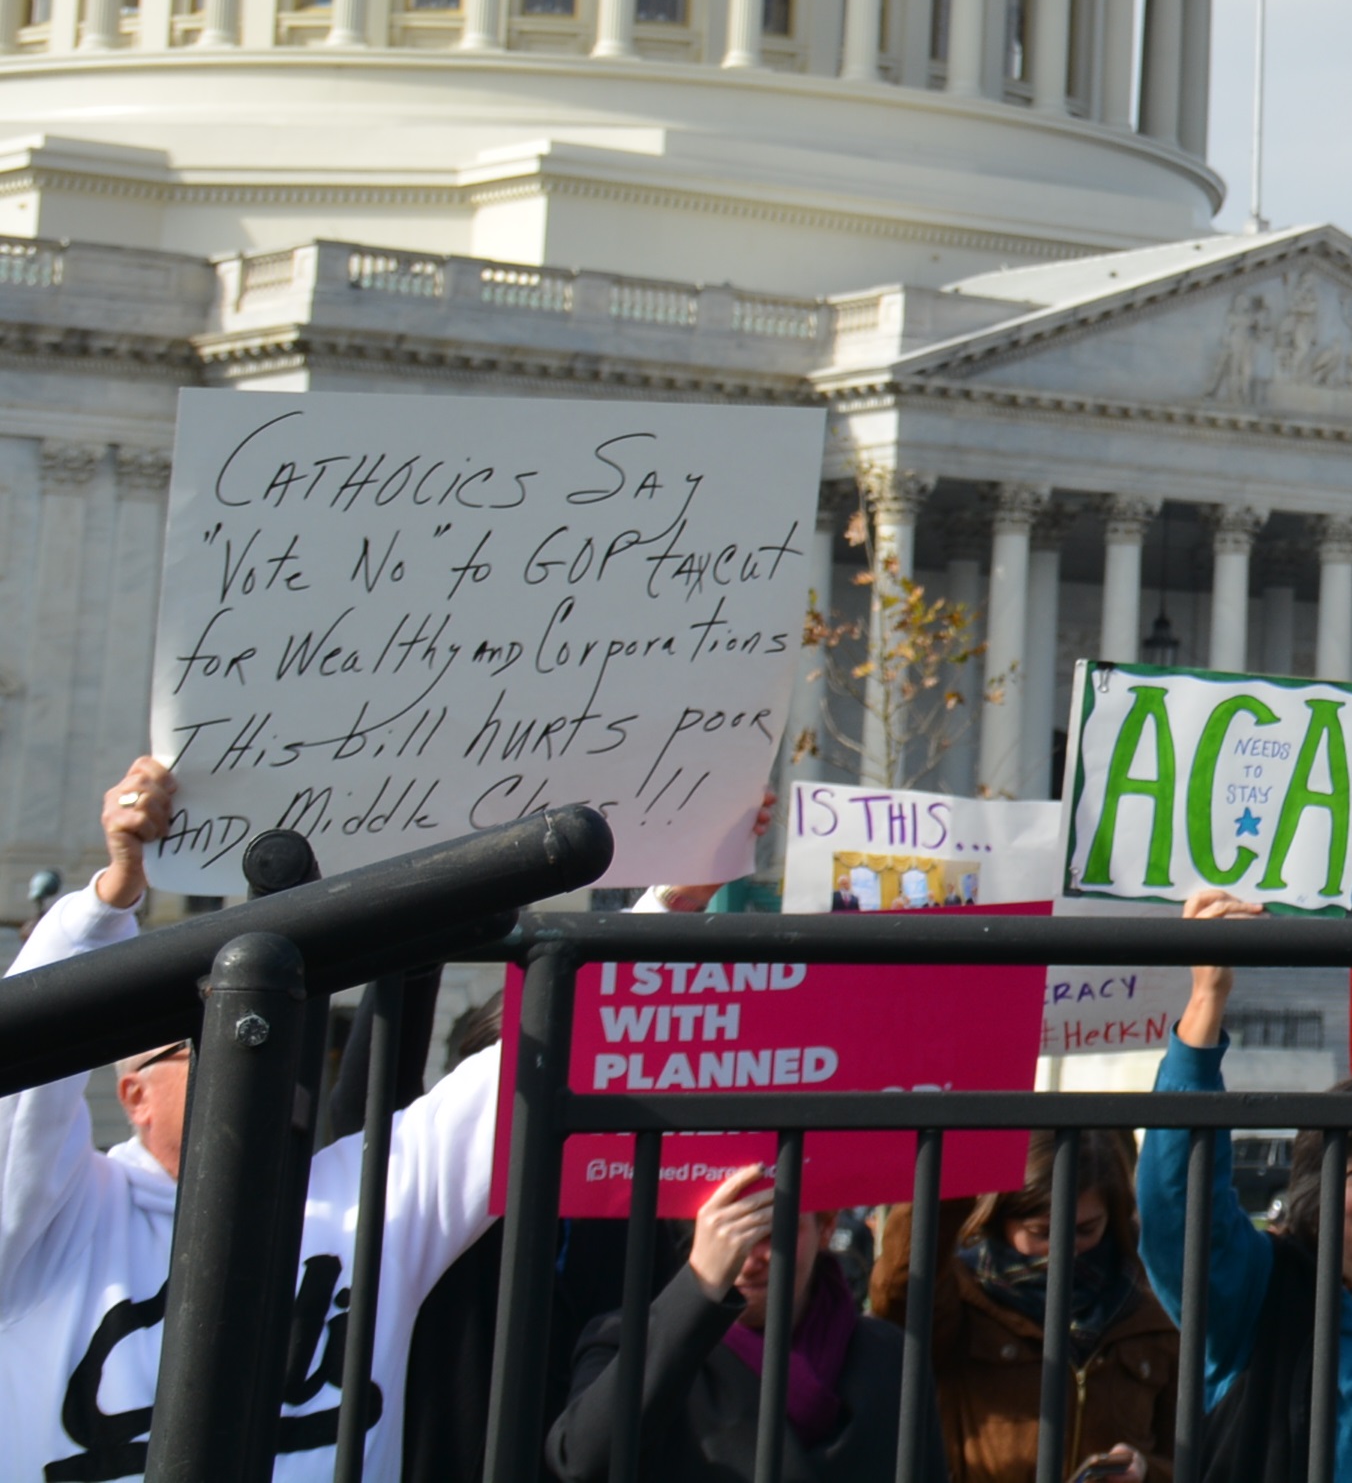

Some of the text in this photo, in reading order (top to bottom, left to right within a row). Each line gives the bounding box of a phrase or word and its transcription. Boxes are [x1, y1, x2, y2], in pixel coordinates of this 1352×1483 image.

[447, 529, 492, 601] to
[524, 525, 641, 582] GOP
[274, 606, 462, 701] Wealthy
[1234, 737, 1291, 760] NEEDS
[1080, 685, 1351, 897] ACA
[1244, 765, 1263, 778] TO
[1227, 784, 1273, 804] STAY
[797, 787, 992, 850] IS THIS...
[600, 962, 807, 996] I STAND
[1043, 975, 1137, 1004] RACY
[600, 1003, 741, 1043] WITH
[593, 1046, 839, 1090] PLANNED
